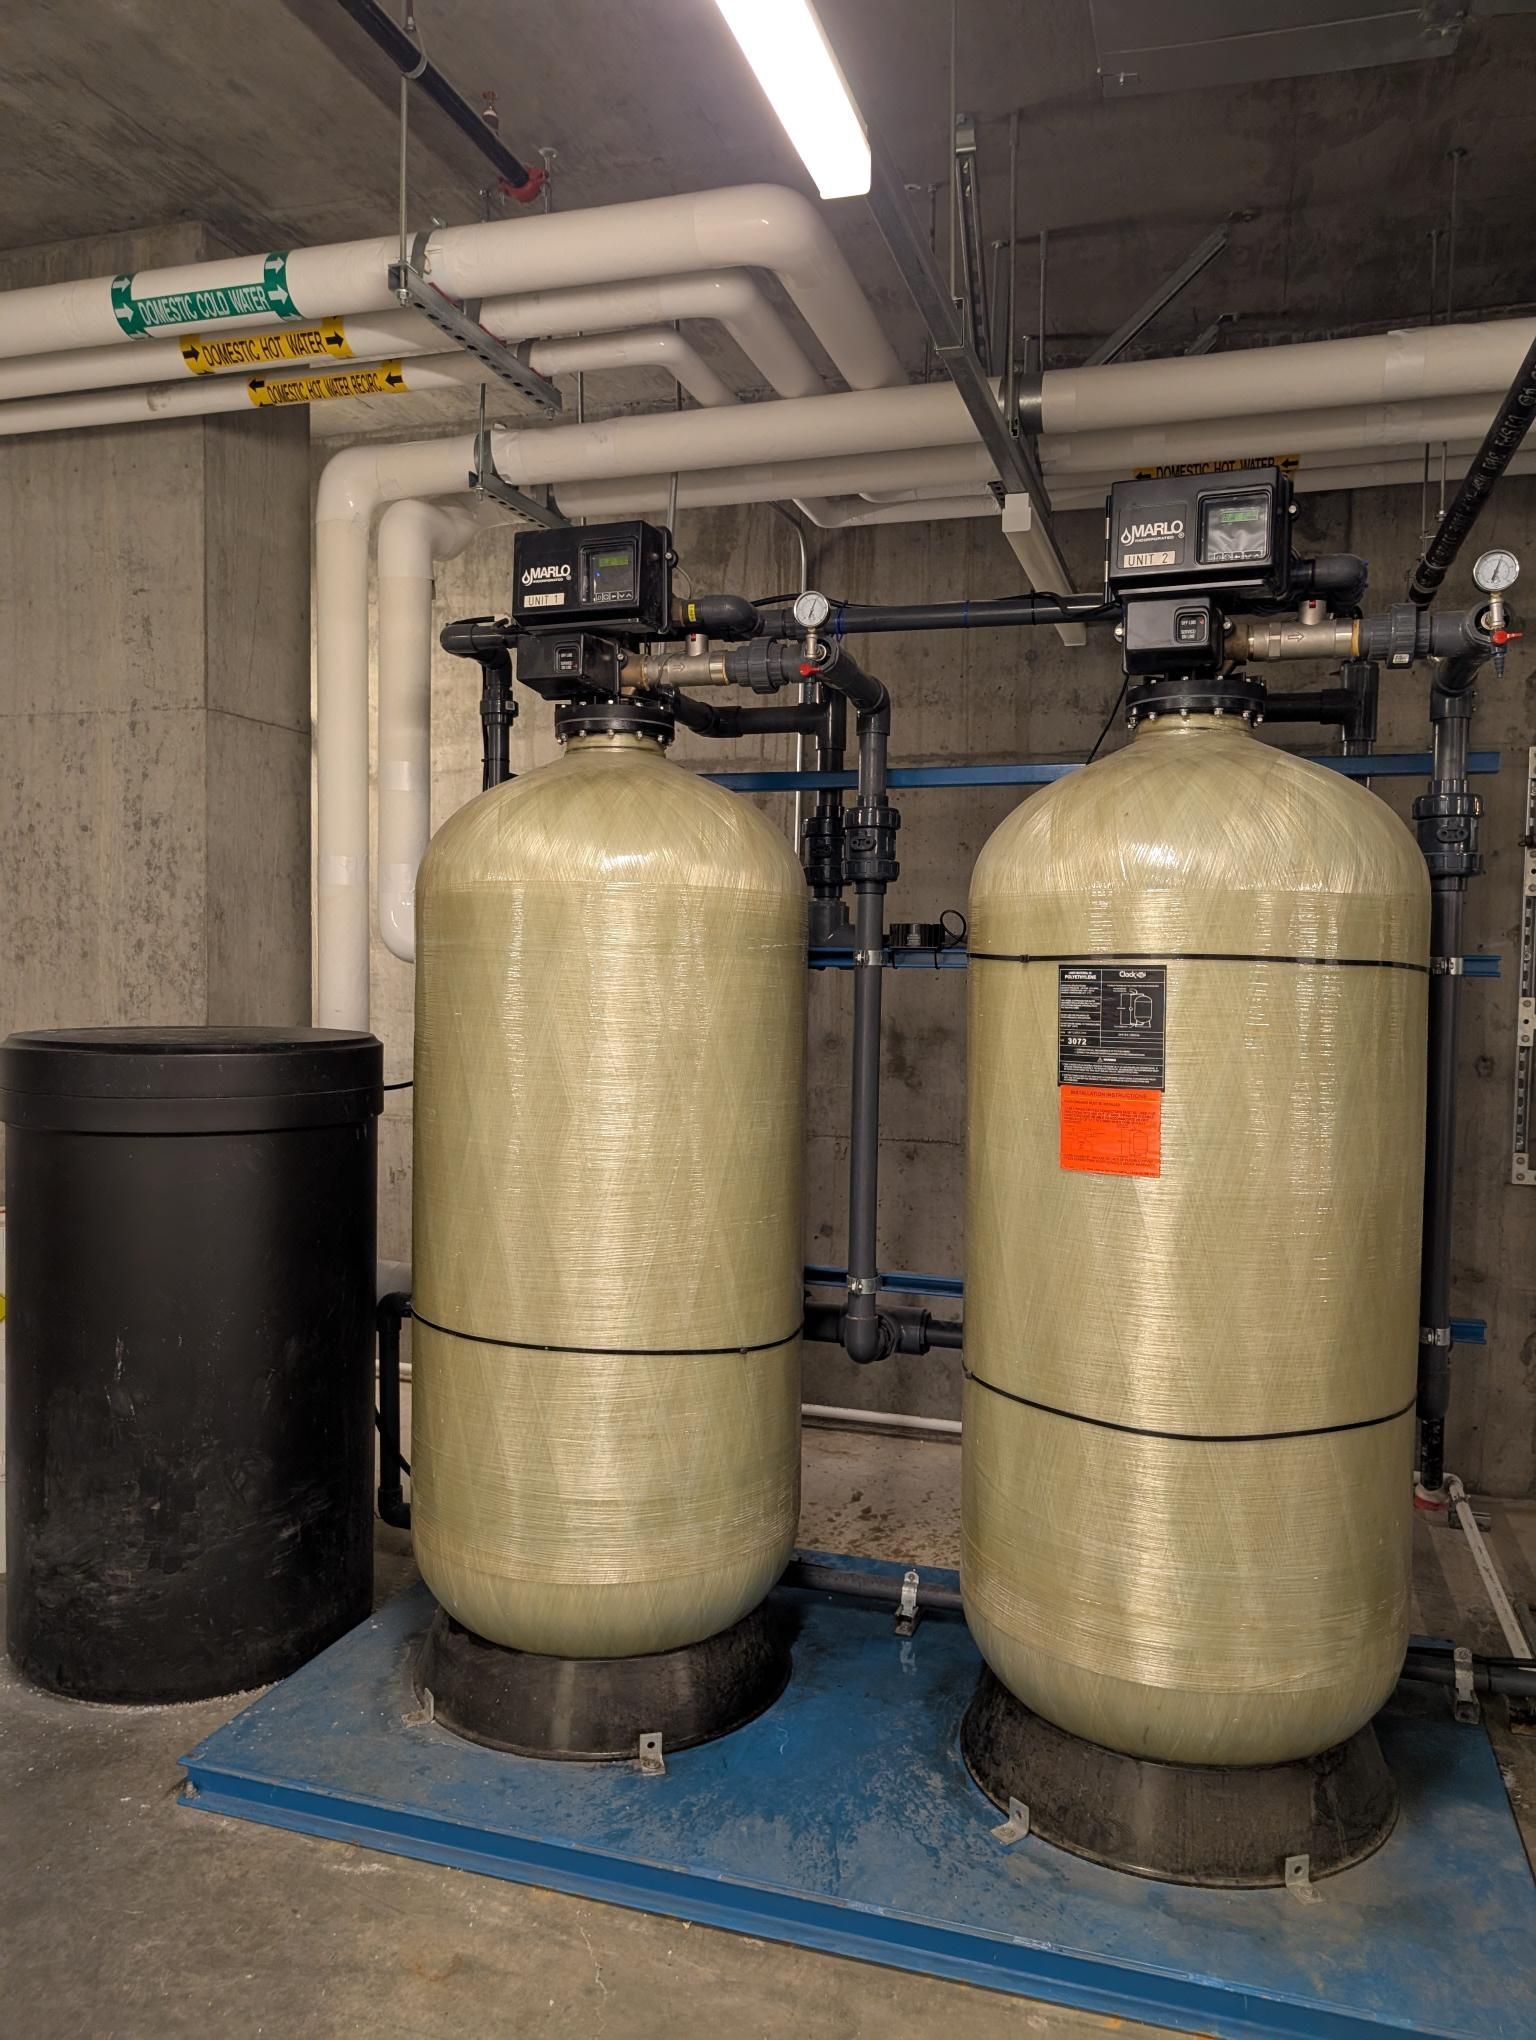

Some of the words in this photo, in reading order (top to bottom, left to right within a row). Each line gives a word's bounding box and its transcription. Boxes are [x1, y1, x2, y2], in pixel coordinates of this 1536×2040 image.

[138, 294, 198, 325] DOMESTIC
[196, 291, 230, 318] COLD
[228, 286, 271, 313] WATER
[201, 339, 260, 366] DOMESTIC
[260, 336, 285, 359] HOT
[286, 331, 327, 355] WATER
[267, 382, 308, 403] DOMESTIC
[306, 379, 325, 399] HOT
[324, 376, 351, 397] WATER
[1156, 463, 1209, 478] DOMESTIC
[1214, 460, 1235, 472] HOT
[1240, 457, 1275, 470] WATER
[1132, 520, 1184, 538] MARLO
[1128, 553, 1154, 566] UNIT
[1162, 552, 1169, 564] 2
[530, 564, 571, 579] MARLO
[528, 595, 548, 606] UNIT
[554, 594, 558, 603] 1
[1067, 1037, 1087, 1045] 3072
